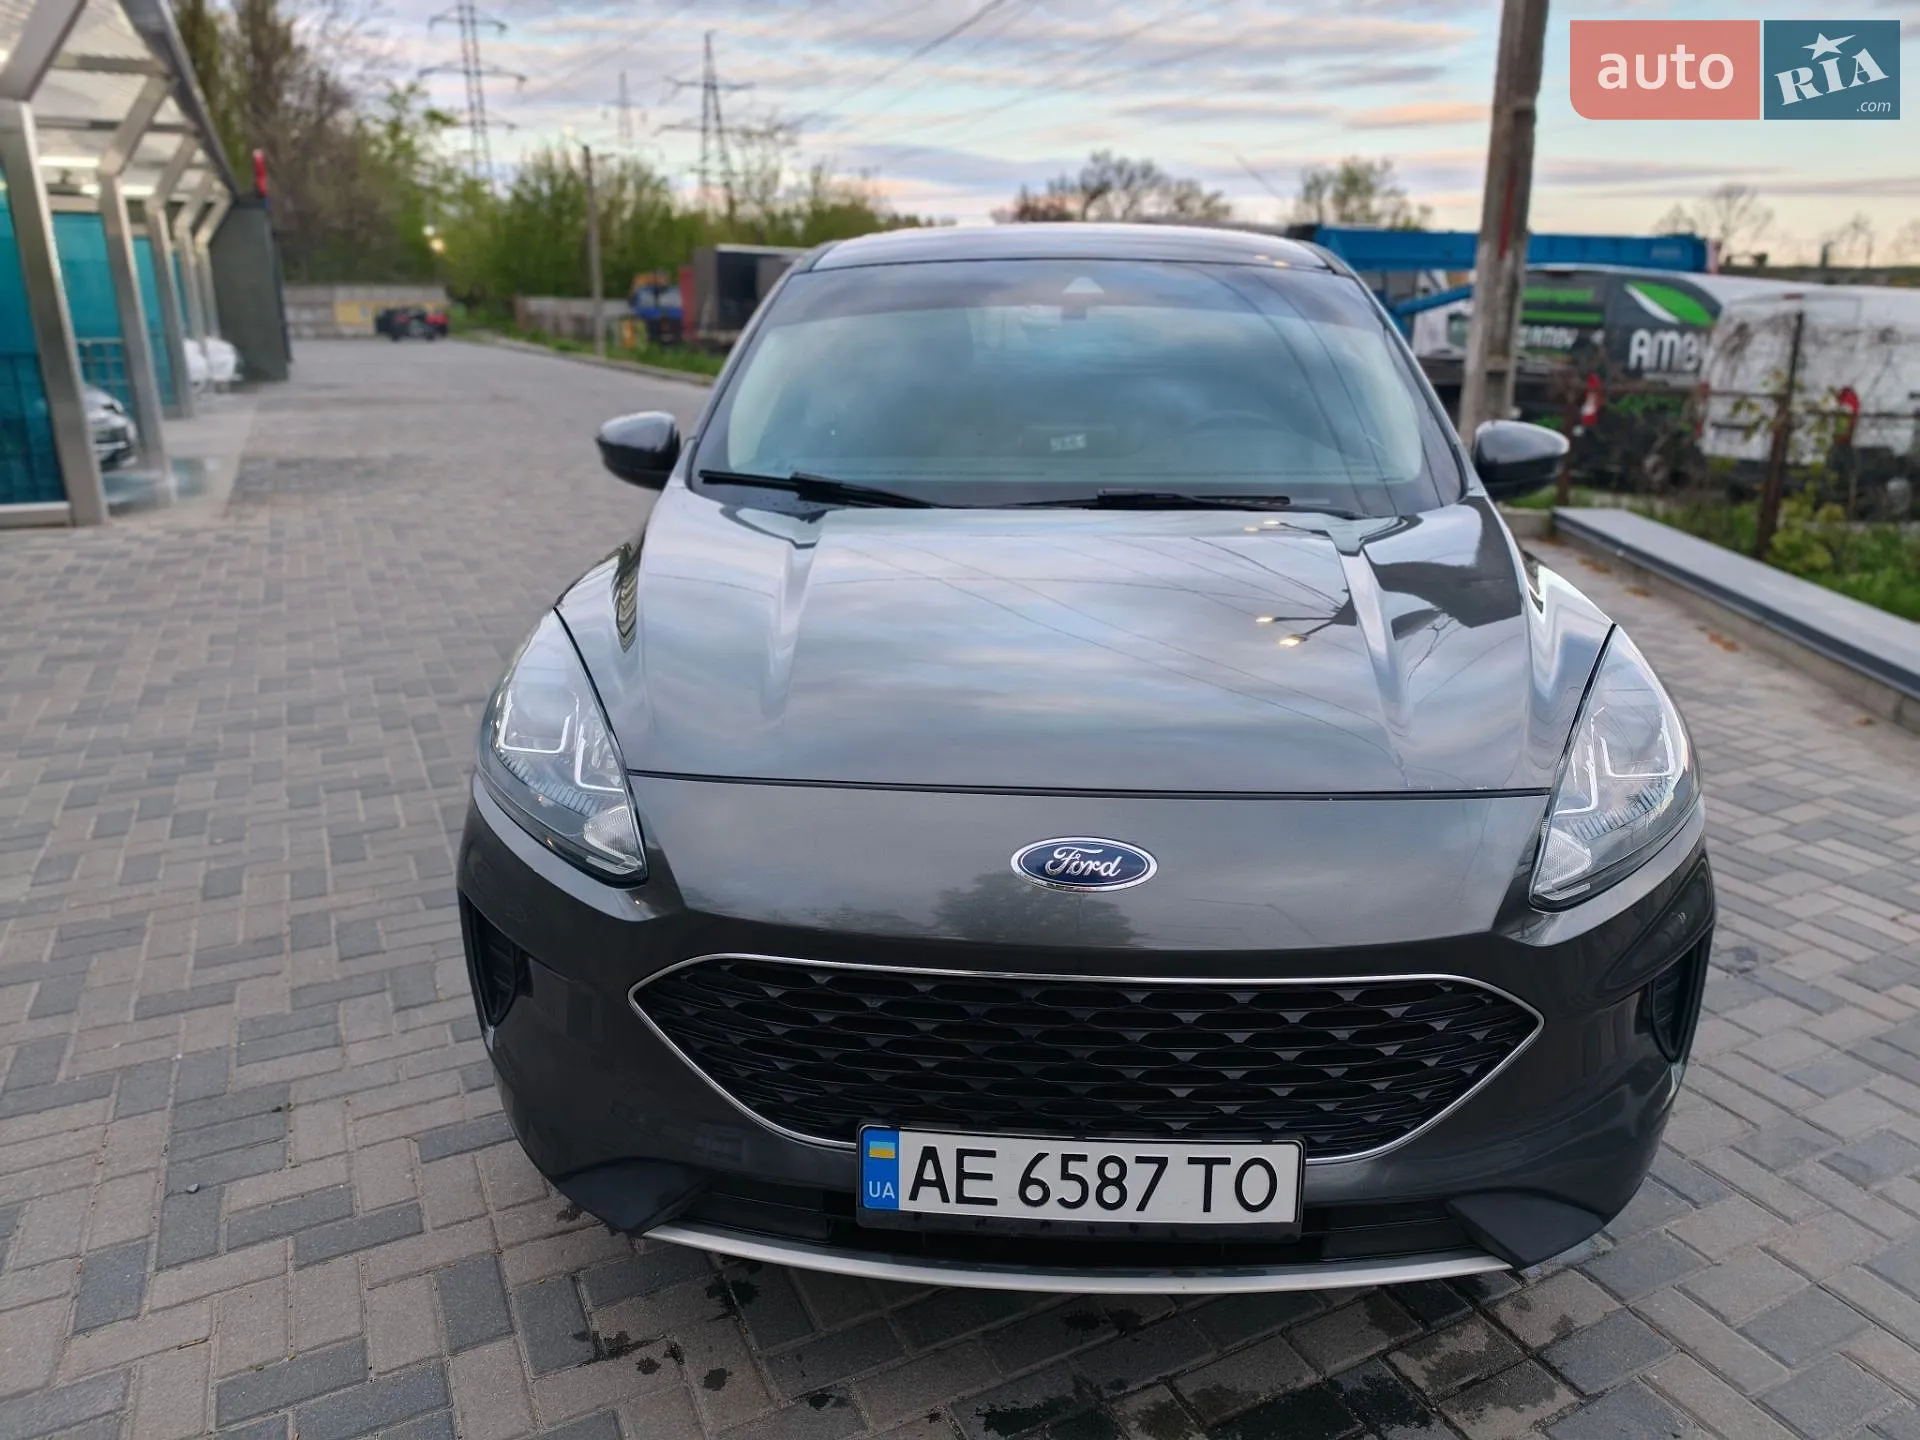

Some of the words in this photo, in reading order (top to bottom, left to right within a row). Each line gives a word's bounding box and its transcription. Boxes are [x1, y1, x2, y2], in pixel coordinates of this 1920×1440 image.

[1045, 846, 1123, 877] Ford
[868, 1181, 896, 1199] UA
[908, 1146, 998, 1206] AE
[1018, 1152, 1169, 1212] 6587
[1187, 1156, 1278, 1213] TO
